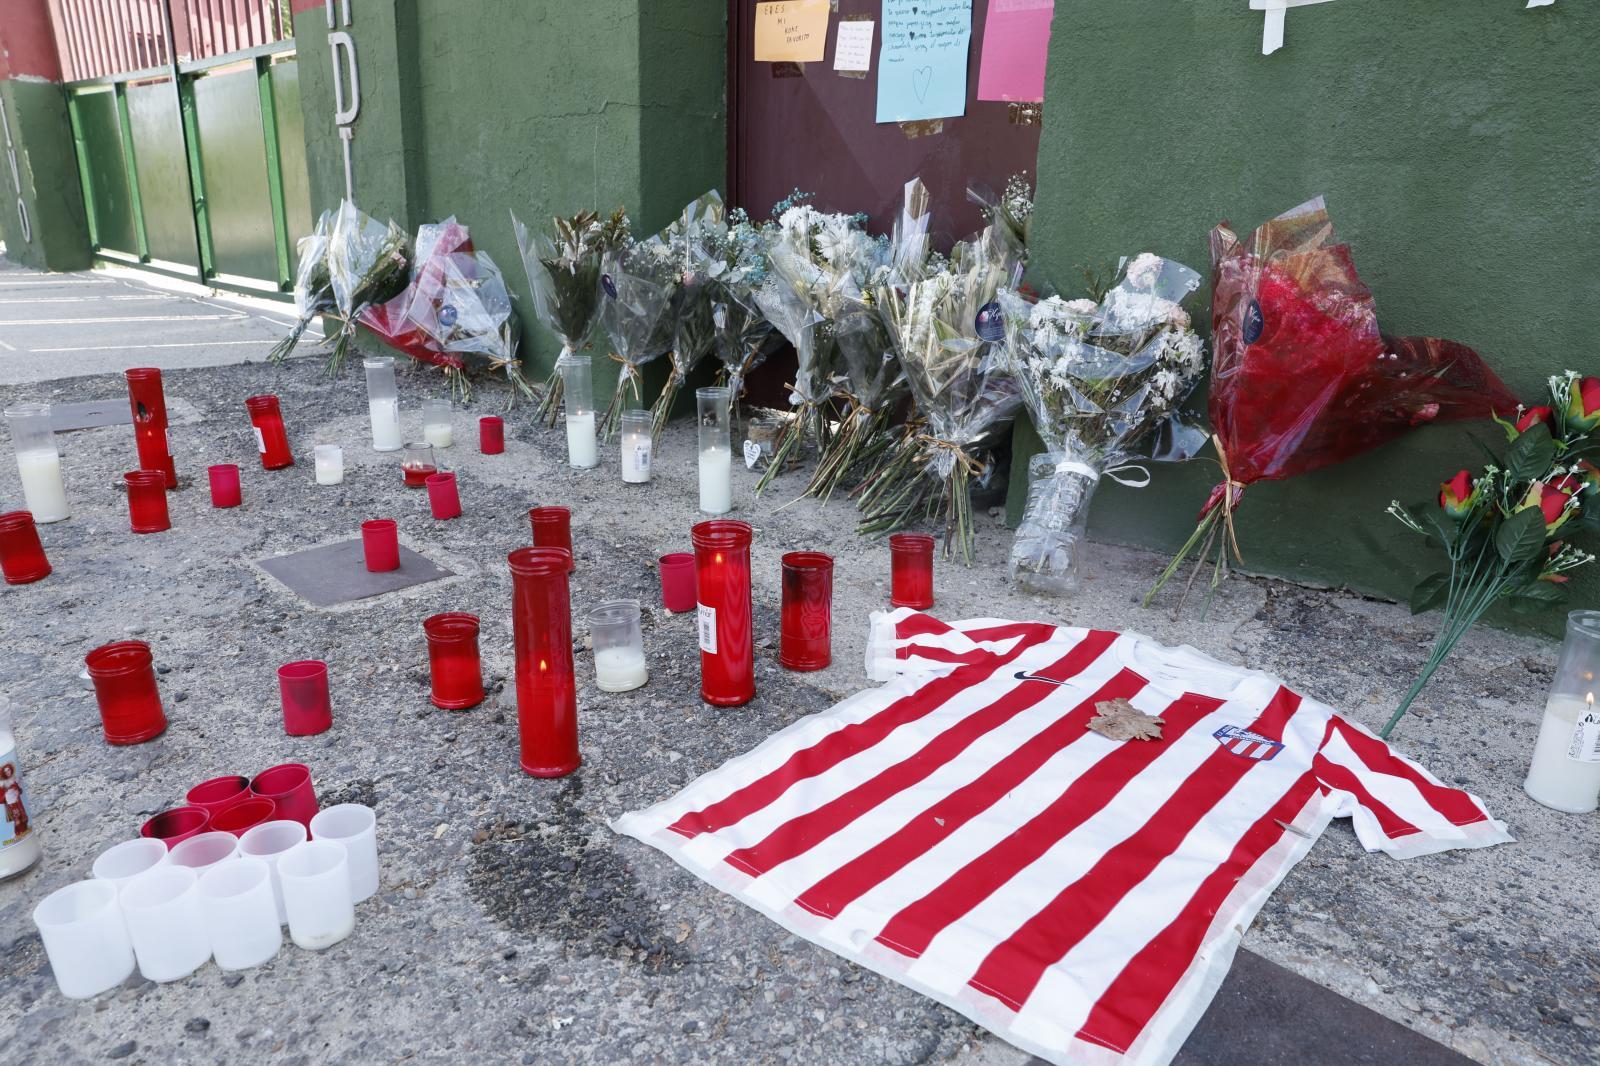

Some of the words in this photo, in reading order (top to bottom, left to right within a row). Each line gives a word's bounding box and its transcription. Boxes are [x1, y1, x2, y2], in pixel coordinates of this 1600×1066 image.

[764, 4, 785, 16] ERES
[777, 17, 786, 25] MI
[786, 33, 810, 43] FAVORITO
